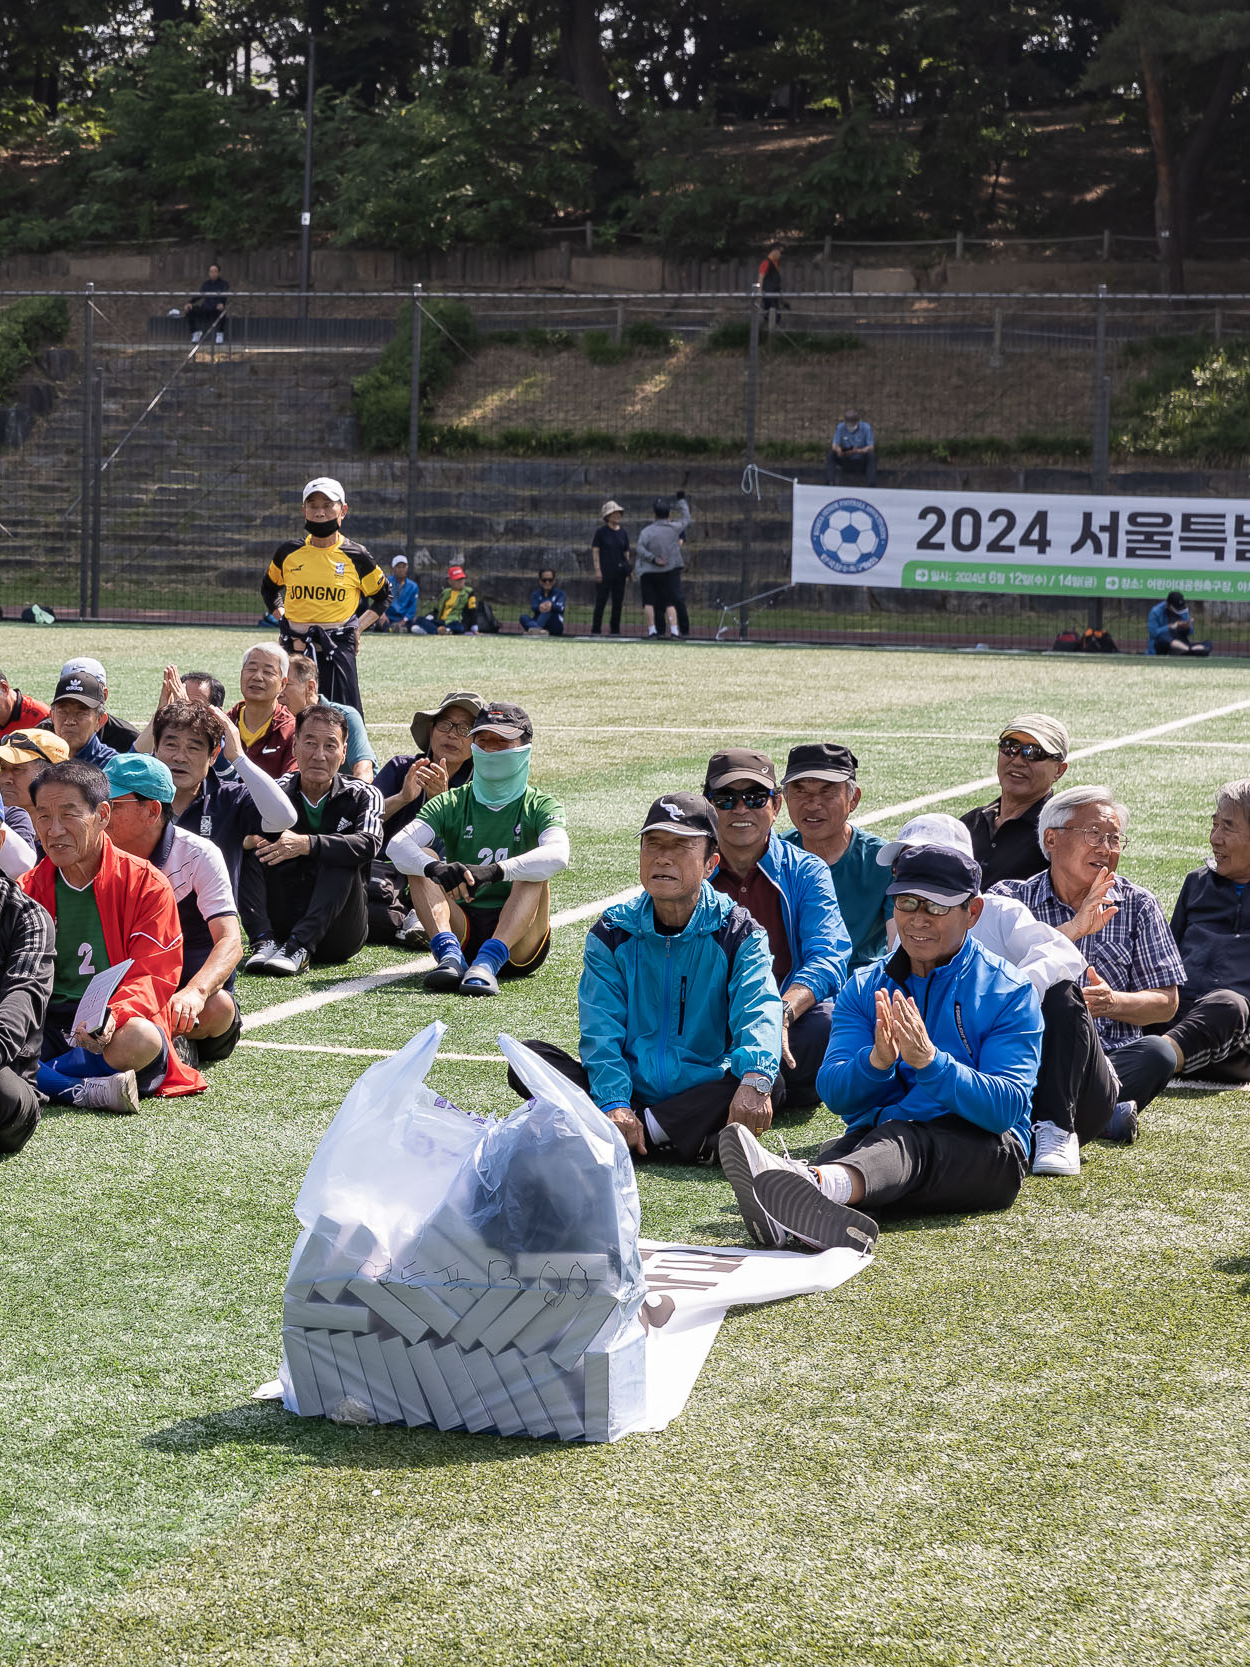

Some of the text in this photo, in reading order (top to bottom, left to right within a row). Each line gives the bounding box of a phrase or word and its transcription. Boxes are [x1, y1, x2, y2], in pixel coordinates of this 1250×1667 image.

[916, 506, 1052, 555] 2024
[988, 572, 1006, 585] 6월
[291, 585, 347, 602] JONGNO
[77, 942, 96, 976] 2
